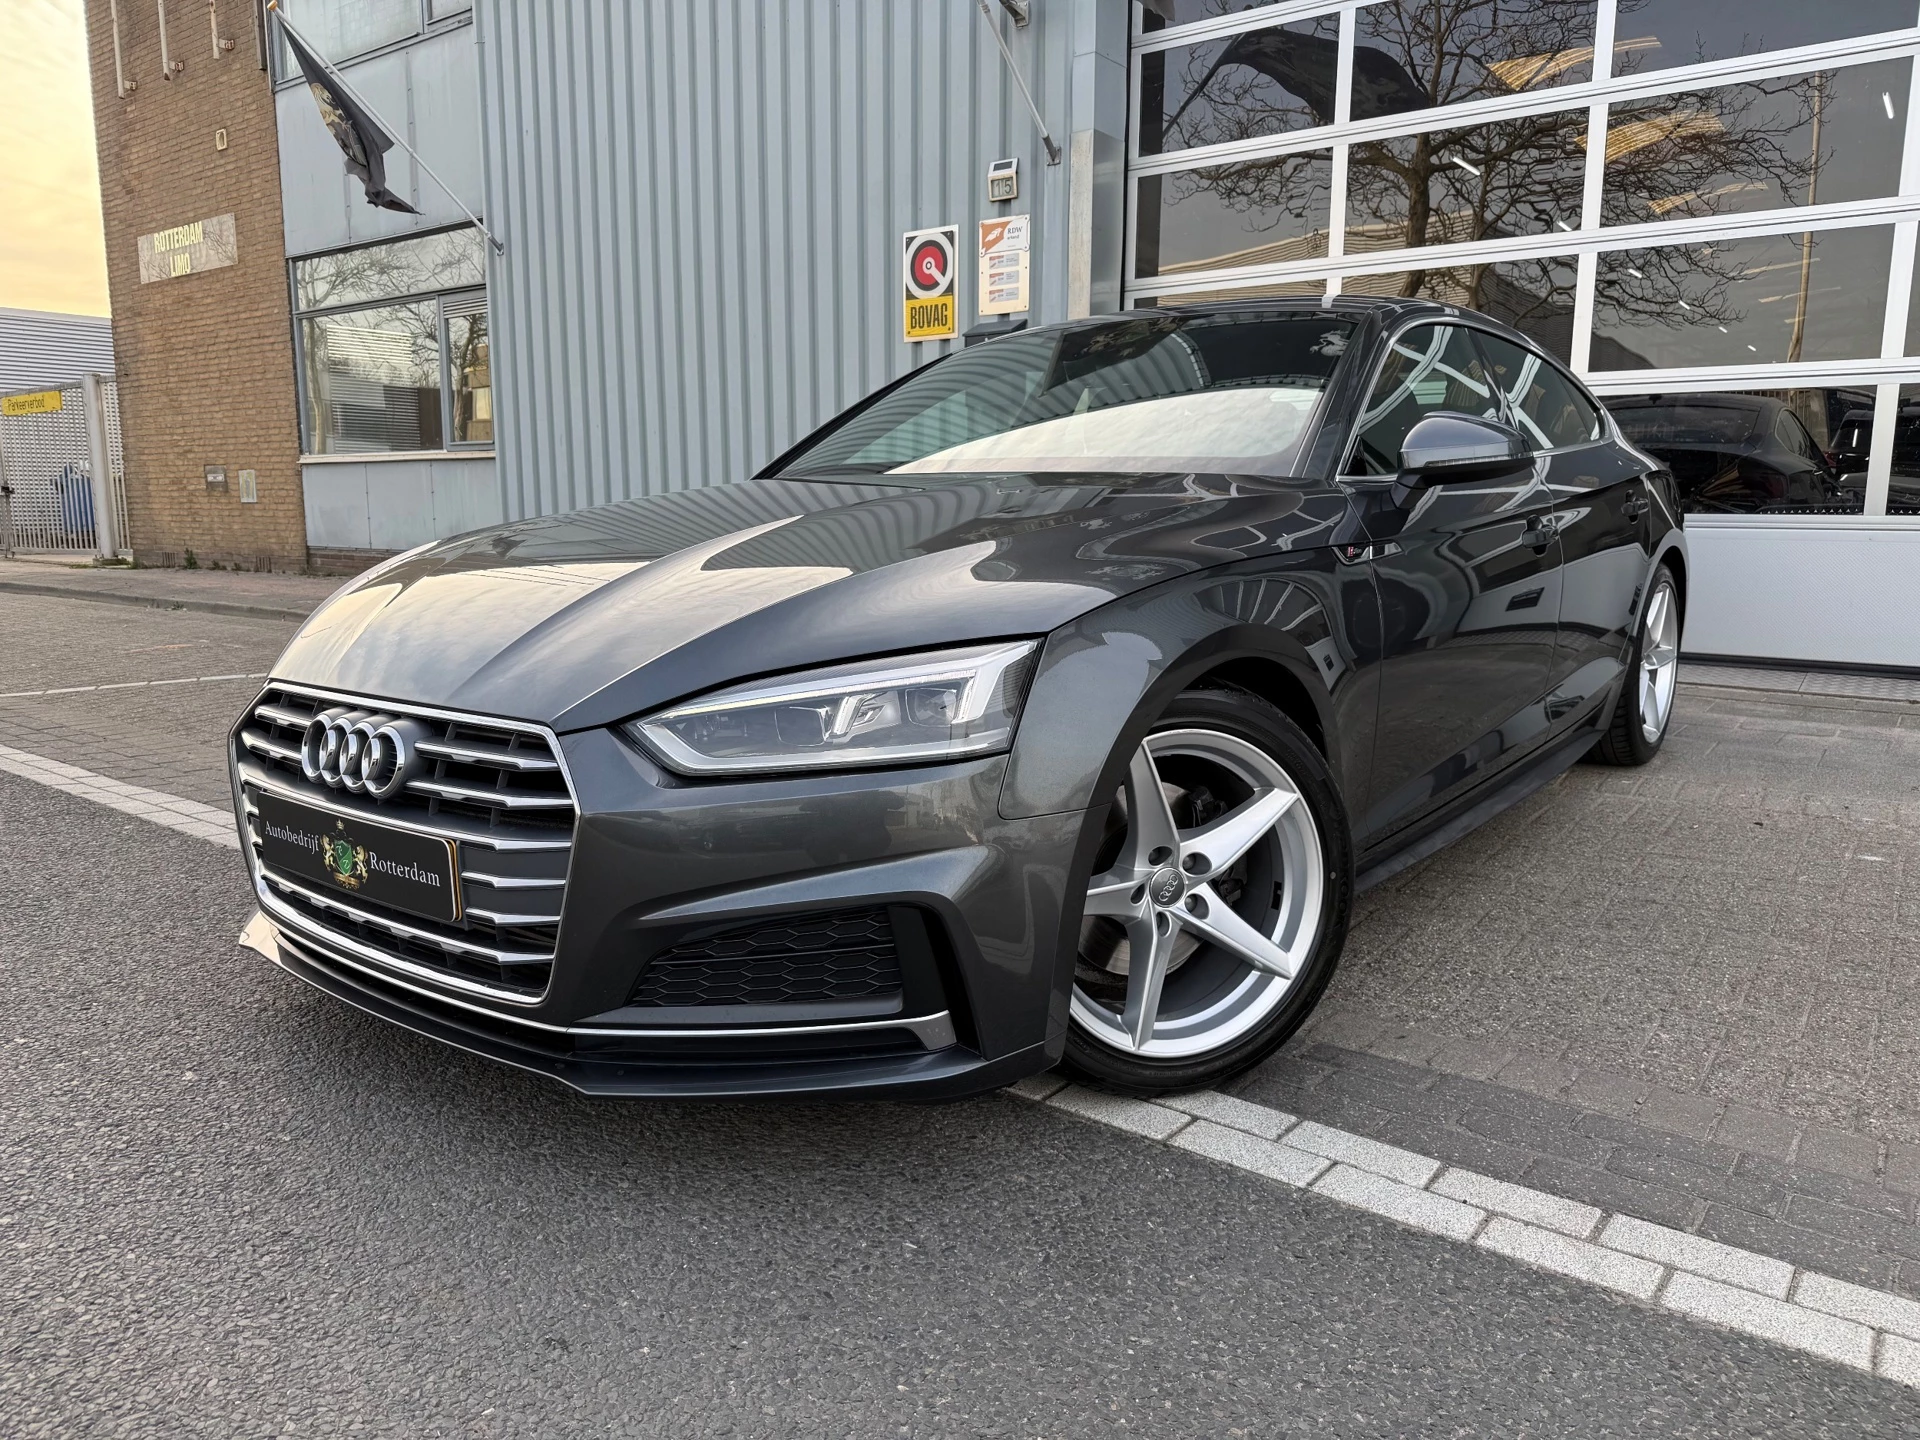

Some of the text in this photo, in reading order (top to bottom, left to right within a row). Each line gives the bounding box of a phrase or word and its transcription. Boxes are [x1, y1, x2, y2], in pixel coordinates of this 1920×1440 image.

[154, 221, 203, 253] ROTTERDAM
[1007, 226, 1023, 235] RDW
[170, 253, 191, 277] LIMO
[910, 303, 948, 329] BOVAG
[8, 395, 45, 411] Parkeerverbod
[265, 821, 441, 887] Autobedrijf Rotterdam
